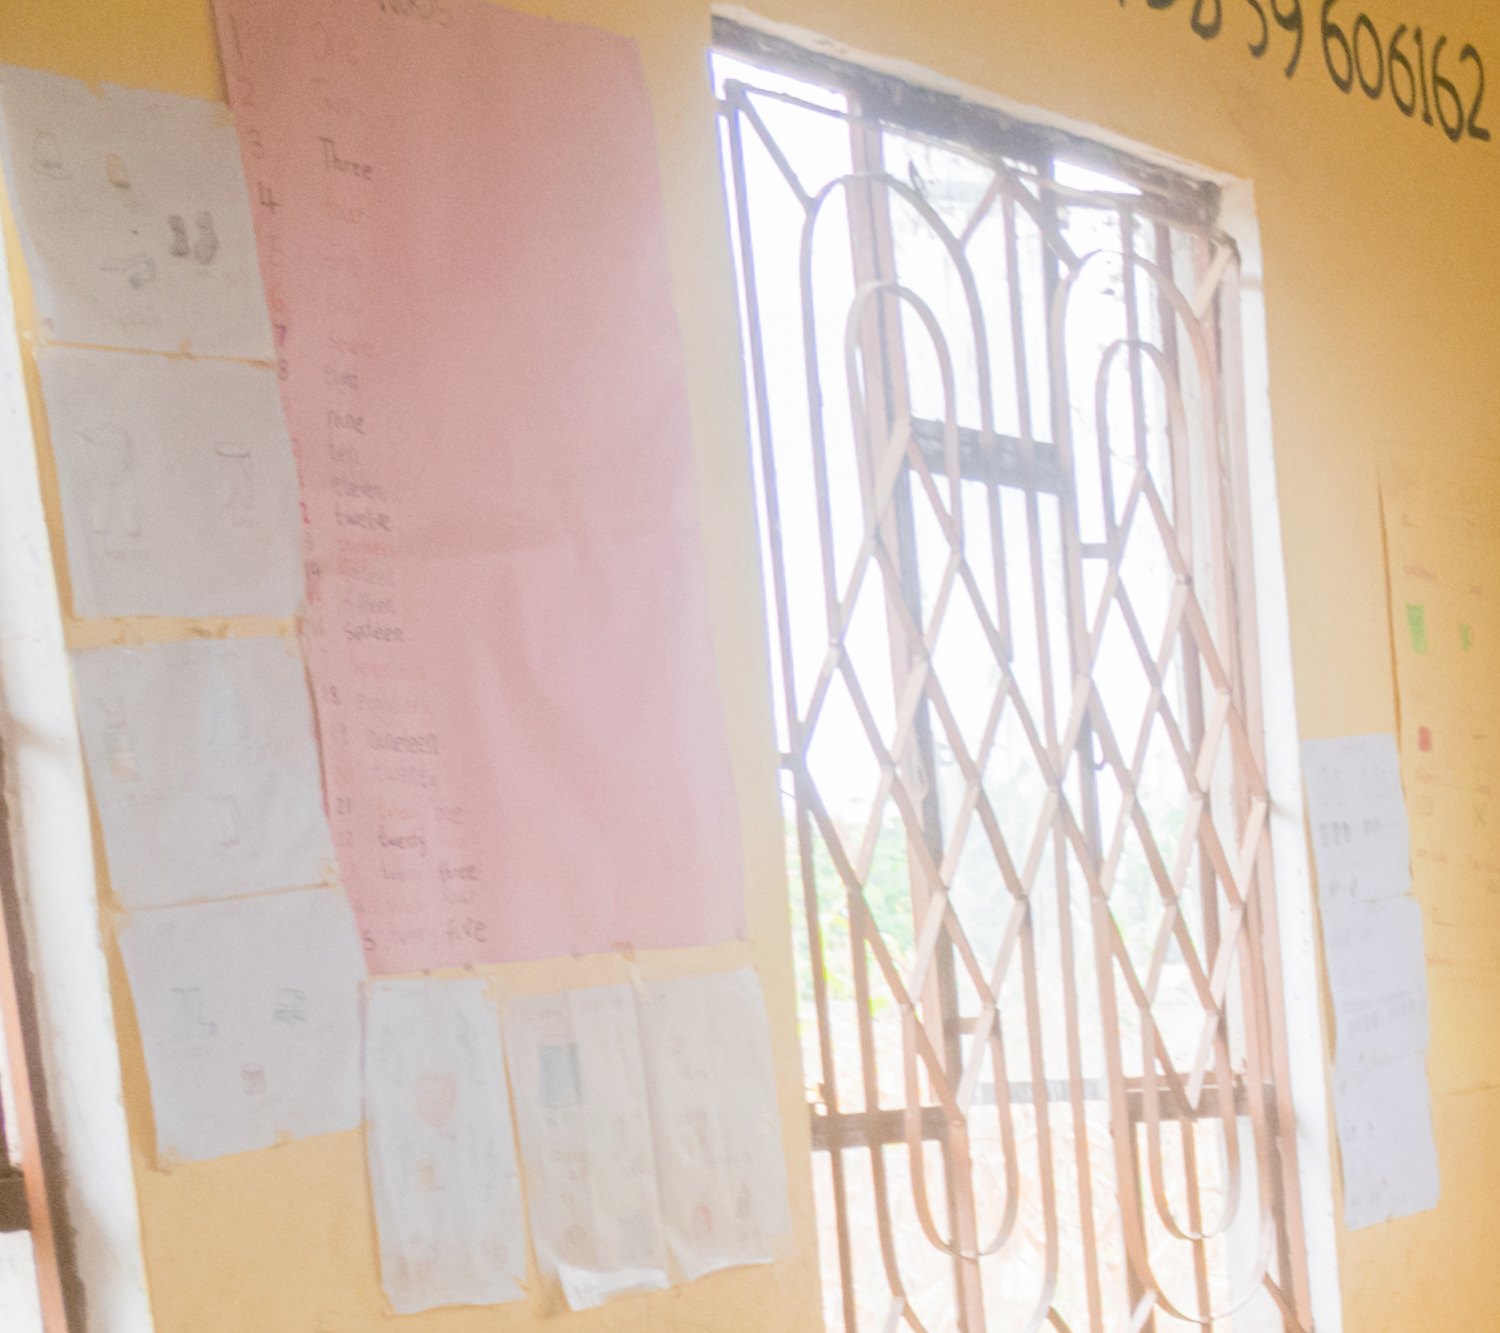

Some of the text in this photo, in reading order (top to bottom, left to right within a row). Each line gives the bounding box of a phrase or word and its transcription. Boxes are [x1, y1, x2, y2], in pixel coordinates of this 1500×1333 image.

[1320, 0, 1385, 100] 60
[1388, 24, 1433, 126] 61
[1431, 35, 1491, 143] 62
[257, 178, 280, 214] 4
